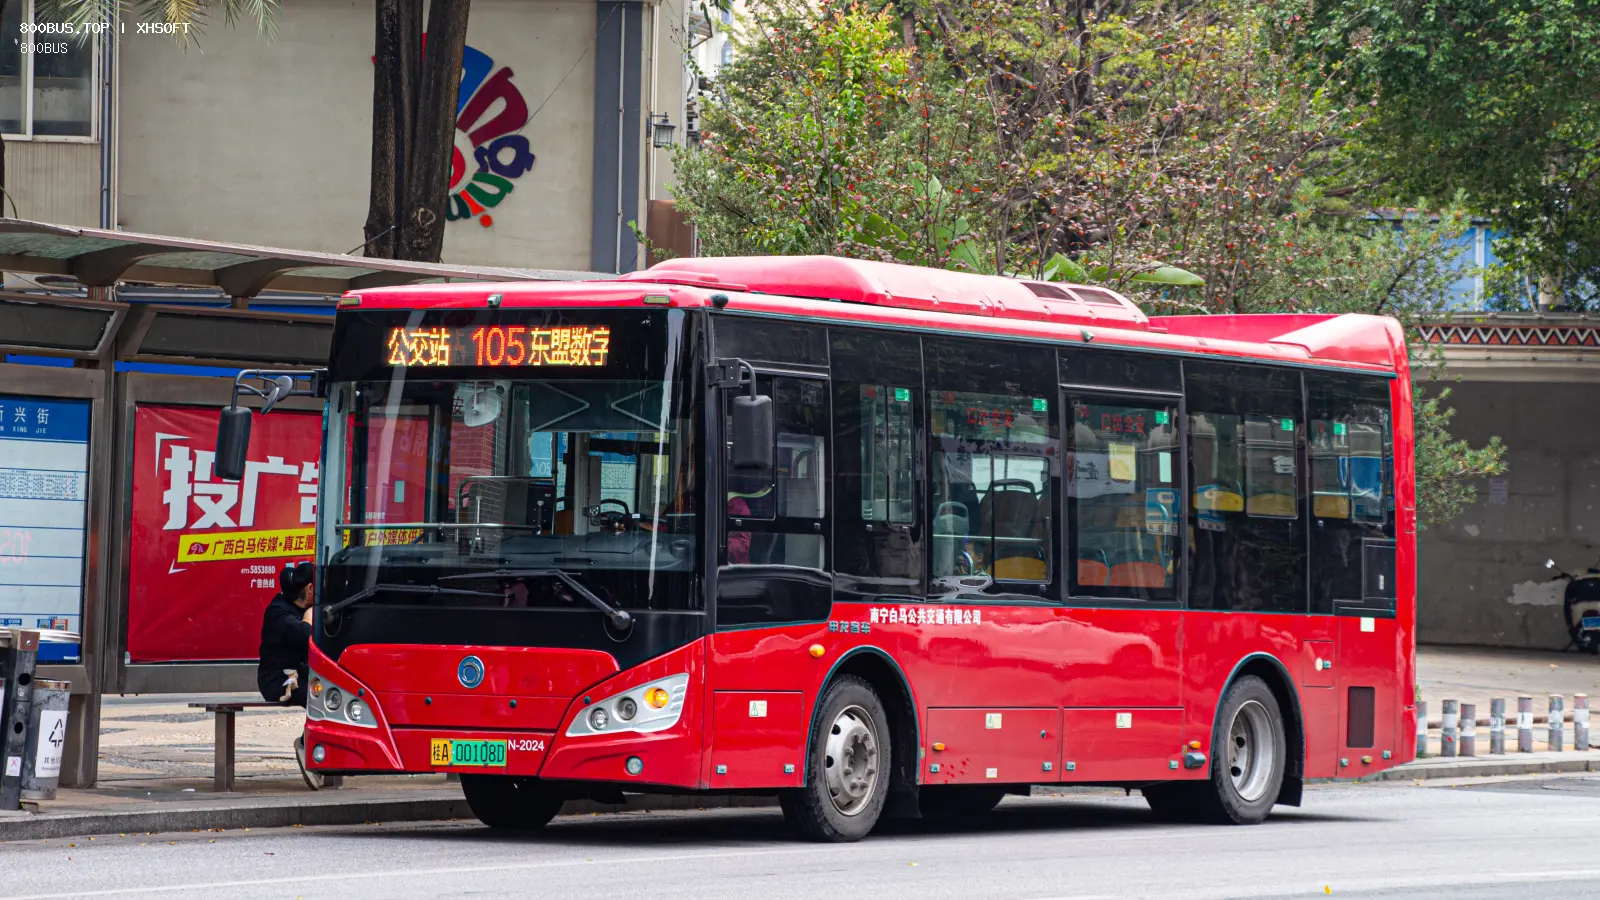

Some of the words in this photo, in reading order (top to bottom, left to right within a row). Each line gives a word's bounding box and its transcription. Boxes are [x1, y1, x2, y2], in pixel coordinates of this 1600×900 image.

[387, 327, 451, 366] 公交站
[471, 326, 526, 366] 105
[528, 326, 611, 366] 东盟数字
[869, 607, 982, 625] 南宁白马公共交通有限公司
[507, 739, 545, 752] N-2024
